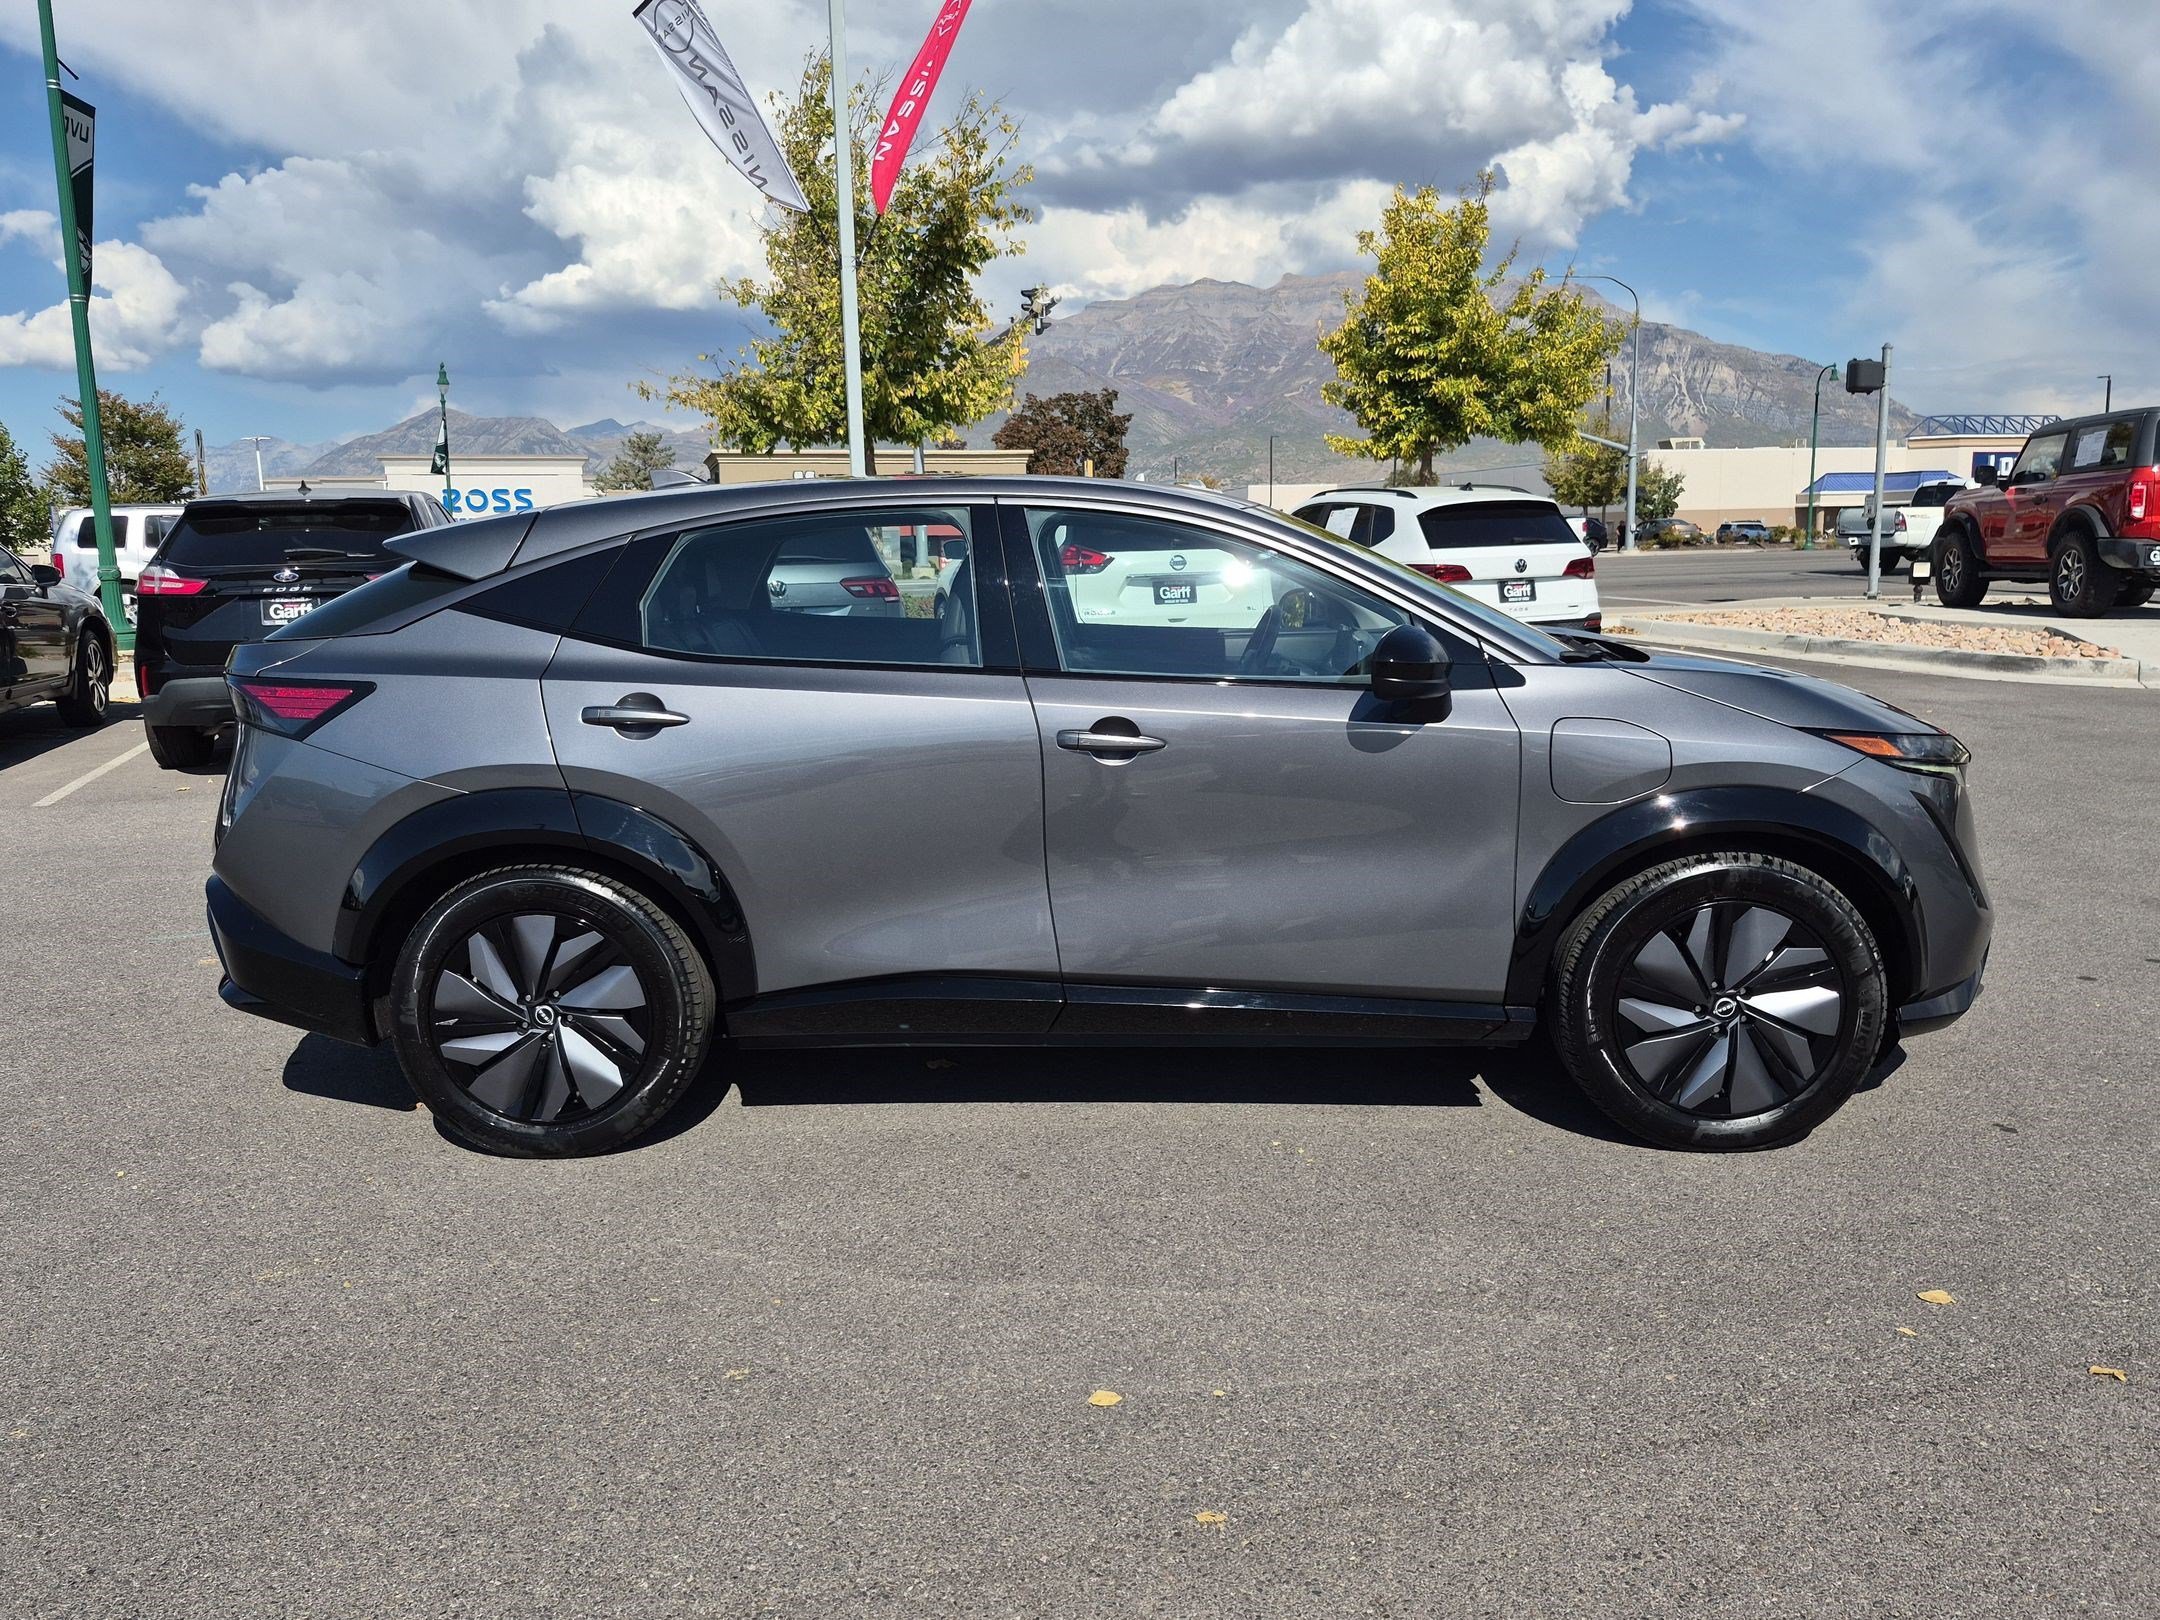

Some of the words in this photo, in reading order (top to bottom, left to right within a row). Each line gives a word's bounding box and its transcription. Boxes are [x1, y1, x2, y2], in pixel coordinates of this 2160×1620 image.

[442, 489, 533, 512] ROSS
[1159, 585, 1191, 599] Garff
[1503, 583, 1531, 598] Garff
[269, 602, 313, 620] Garff
